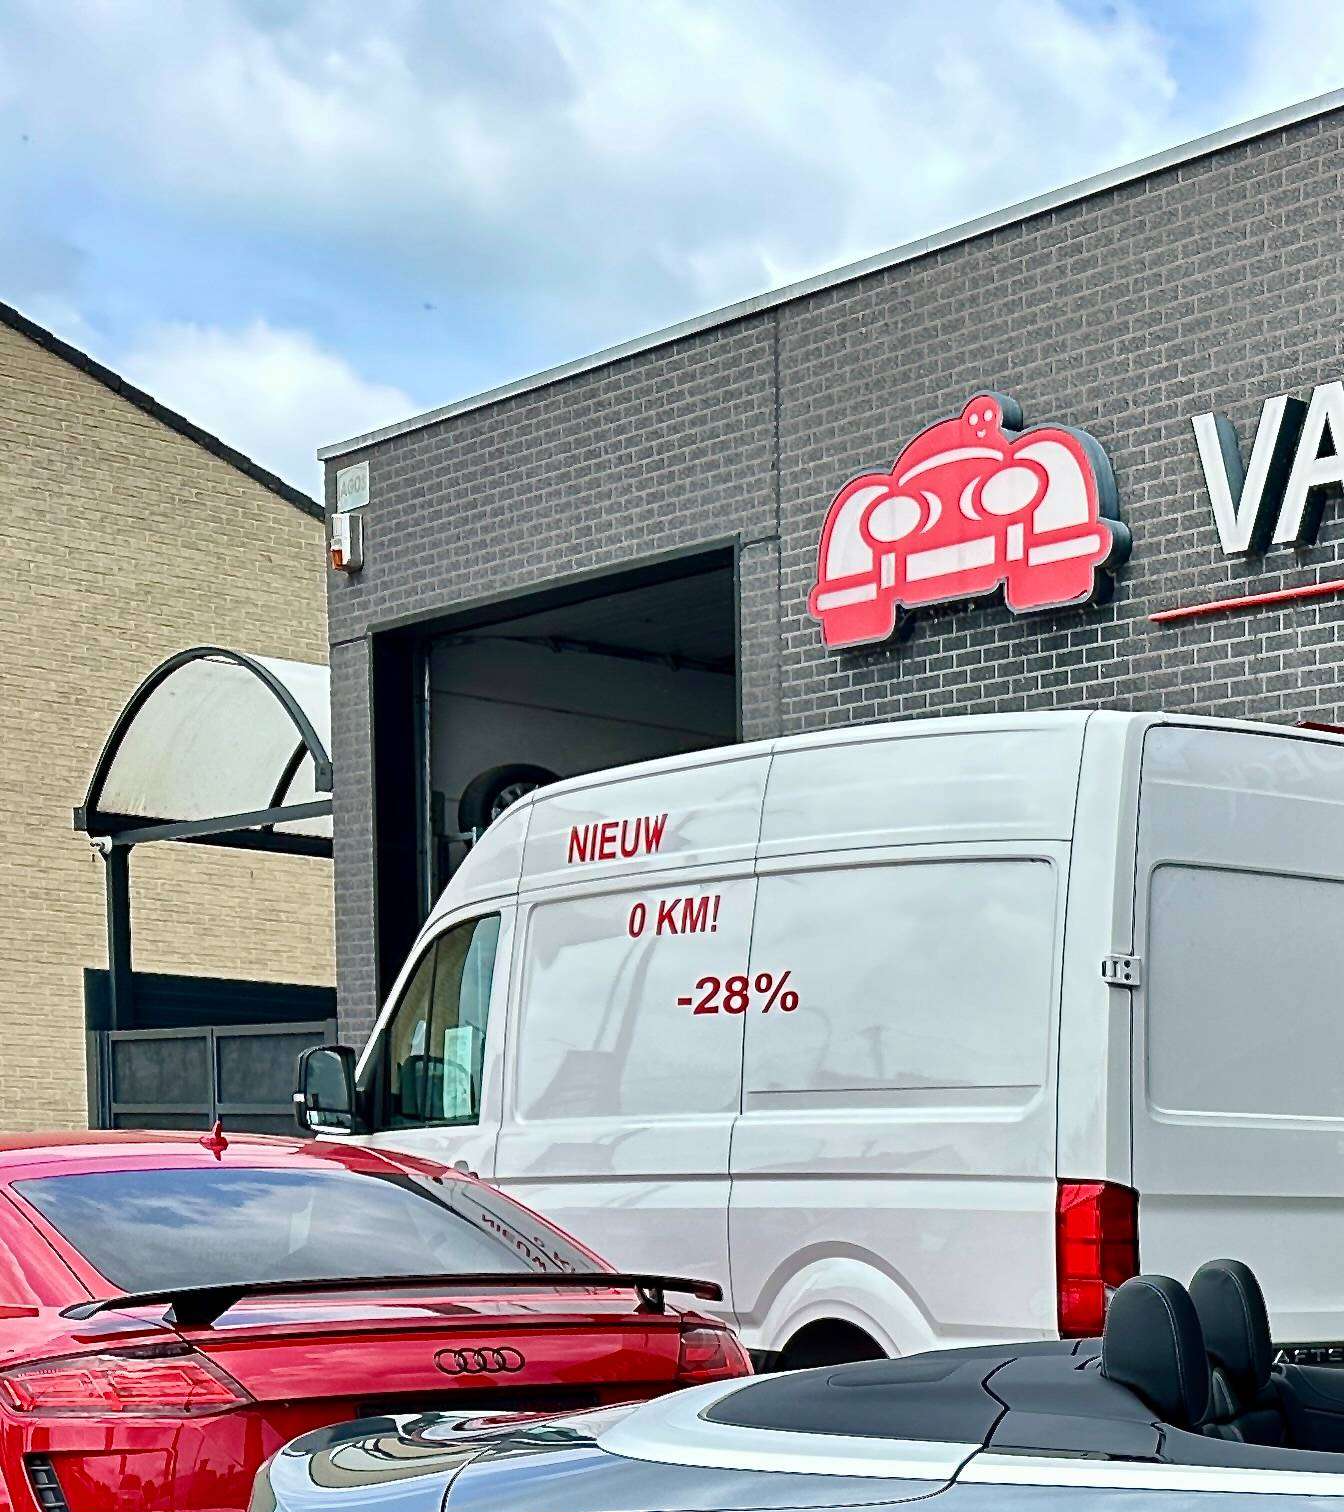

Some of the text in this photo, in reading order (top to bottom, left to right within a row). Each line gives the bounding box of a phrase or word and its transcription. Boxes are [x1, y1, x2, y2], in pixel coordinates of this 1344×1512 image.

[567, 813, 668, 863] NIEUW
[628, 895, 721, 938] 0 KM!
[677, 970, 800, 1015] -28%
